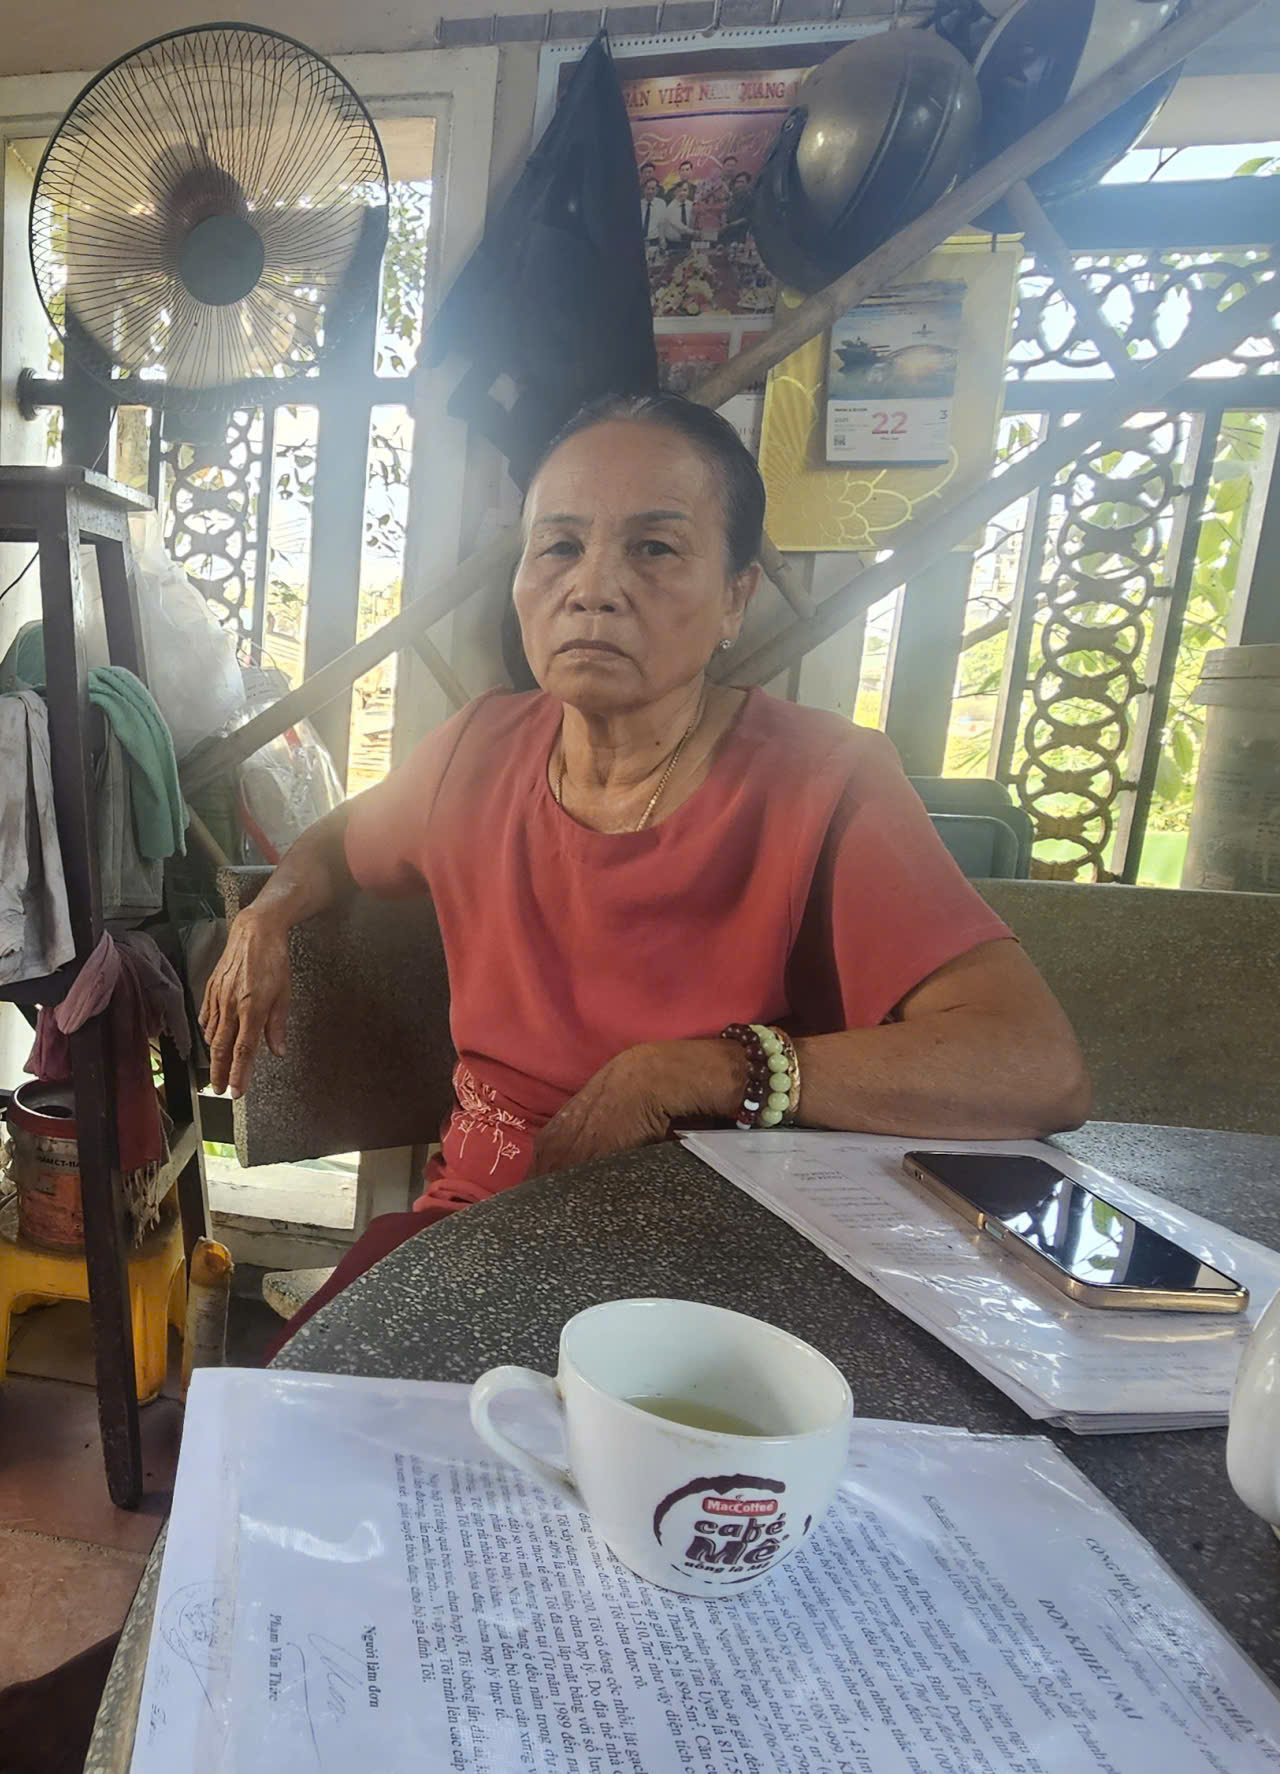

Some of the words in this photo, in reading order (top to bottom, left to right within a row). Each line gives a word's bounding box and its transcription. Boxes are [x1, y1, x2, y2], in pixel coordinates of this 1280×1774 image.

[658, 82, 694, 108] VIỆT
[871, 411, 908, 435] 22
[707, 1499, 775, 1514] MacCoffee
[694, 1512, 787, 1543] café
[946, 1573, 978, 1604] UBND
[986, 1577, 1017, 1608] UBND
[543, 1595, 561, 1610] Tôi
[608, 1604, 626, 1619] Tôi
[266, 1613, 281, 1643] Phạm
[568, 1614, 583, 1638] chưa
[587, 1616, 604, 1632] Tôi
[614, 1621, 630, 1644] chưa
[762, 1609, 789, 1642] UBND
[361, 1625, 379, 1659] Người
[416, 1636, 432, 1658] đình
[575, 1640, 589, 1660] hợp
[592, 1634, 608, 1646] có
[269, 1647, 282, 1668] Văn
[456, 1650, 473, 1666] Tôi
[480, 1645, 495, 1664] hợp
[537, 1650, 557, 1670] (Từ
[597, 1649, 613, 1674] đóng
[622, 1647, 640, 1672] được
[365, 1661, 380, 1681] làm
[439, 1657, 454, 1674] Tôi
[504, 1663, 520, 1676] bù
[524, 1662, 543, 1682] đều
[669, 1668, 684, 1677] là
[441, 1677, 458, 1702] trình
[460, 1669, 476, 1702] không
[507, 1679, 523, 1705] chưa
[545, 1673, 560, 1696] năm
[586, 1679, 601, 1696] Do
[967, 1671, 996, 1699] 1957,
[367, 1684, 381, 1707] đơn
[445, 1705, 461, 1723] lên
[552, 1701, 572, 1728] 1989
[591, 1699, 609, 1718] địa
[647, 1663, 664, 1684] như
[664, 1709, 683, 1734] diện
[674, 1739, 694, 1762] tích
[767, 1702, 784, 1720] thu
[577, 1716, 595, 1734] với
[710, 1724, 727, 1735] là
[449, 1726, 462, 1746] các
[560, 1731, 581, 1753] đến
[582, 1738, 604, 1752] số
[622, 1732, 638, 1746] lát
[753, 1713, 793, 1773] 27/06/202
[604, 1742, 624, 1765] nhà
